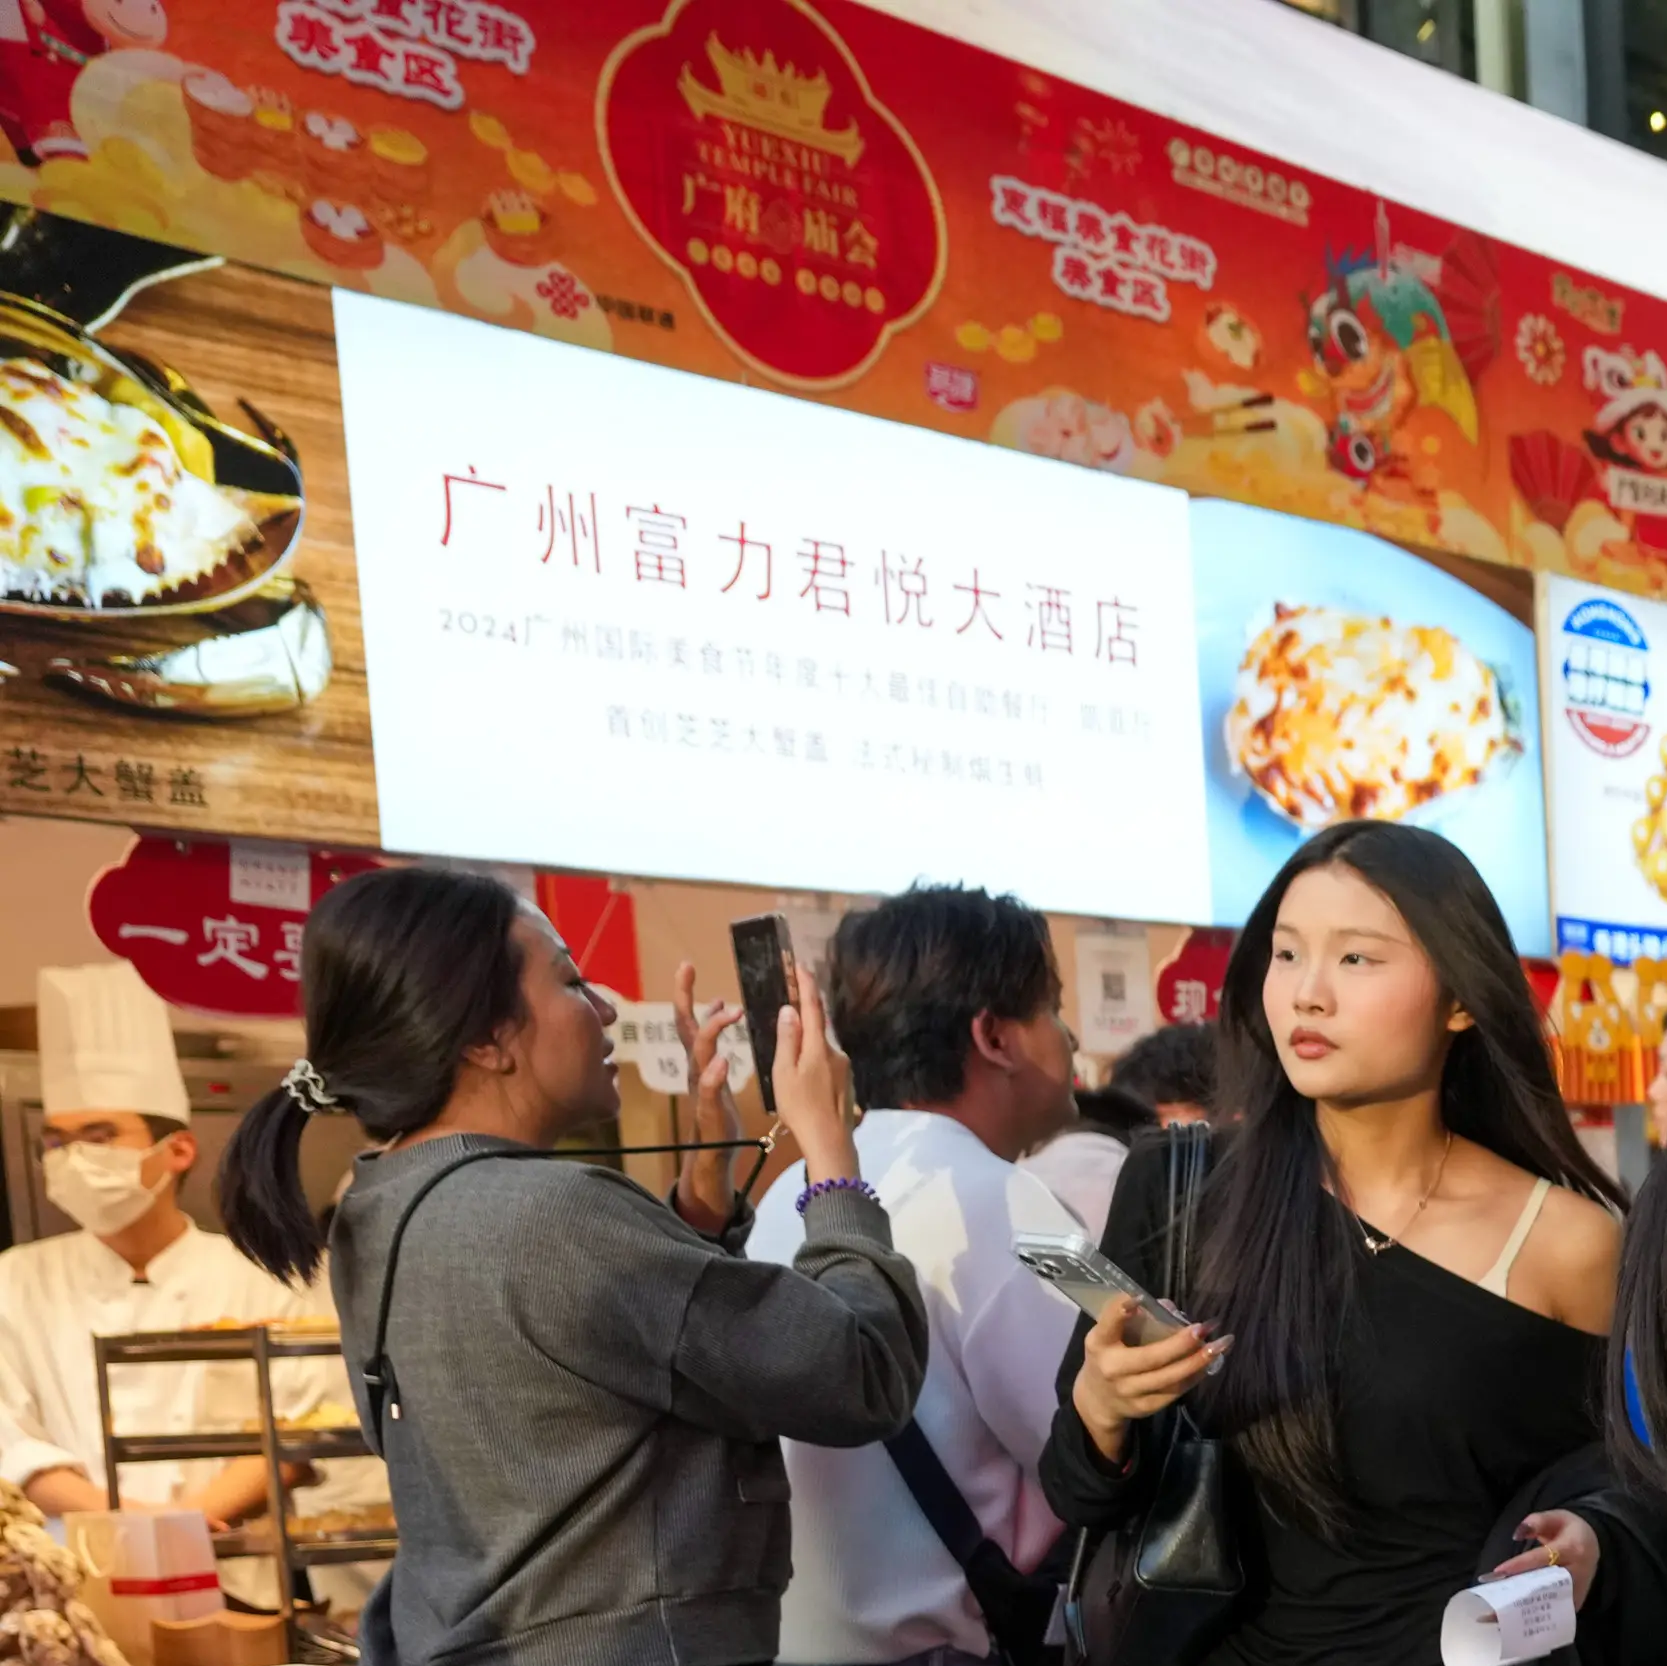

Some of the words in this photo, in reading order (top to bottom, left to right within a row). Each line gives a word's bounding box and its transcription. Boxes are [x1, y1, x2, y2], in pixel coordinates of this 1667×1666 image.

[288, 12, 454, 98] 美食区
[437, 464, 1142, 668] 广州富力君悦大酒店
[605, 703, 829, 763] 首创芝芝大蟹盖
[7, 747, 208, 807] 芝大蟹盖
